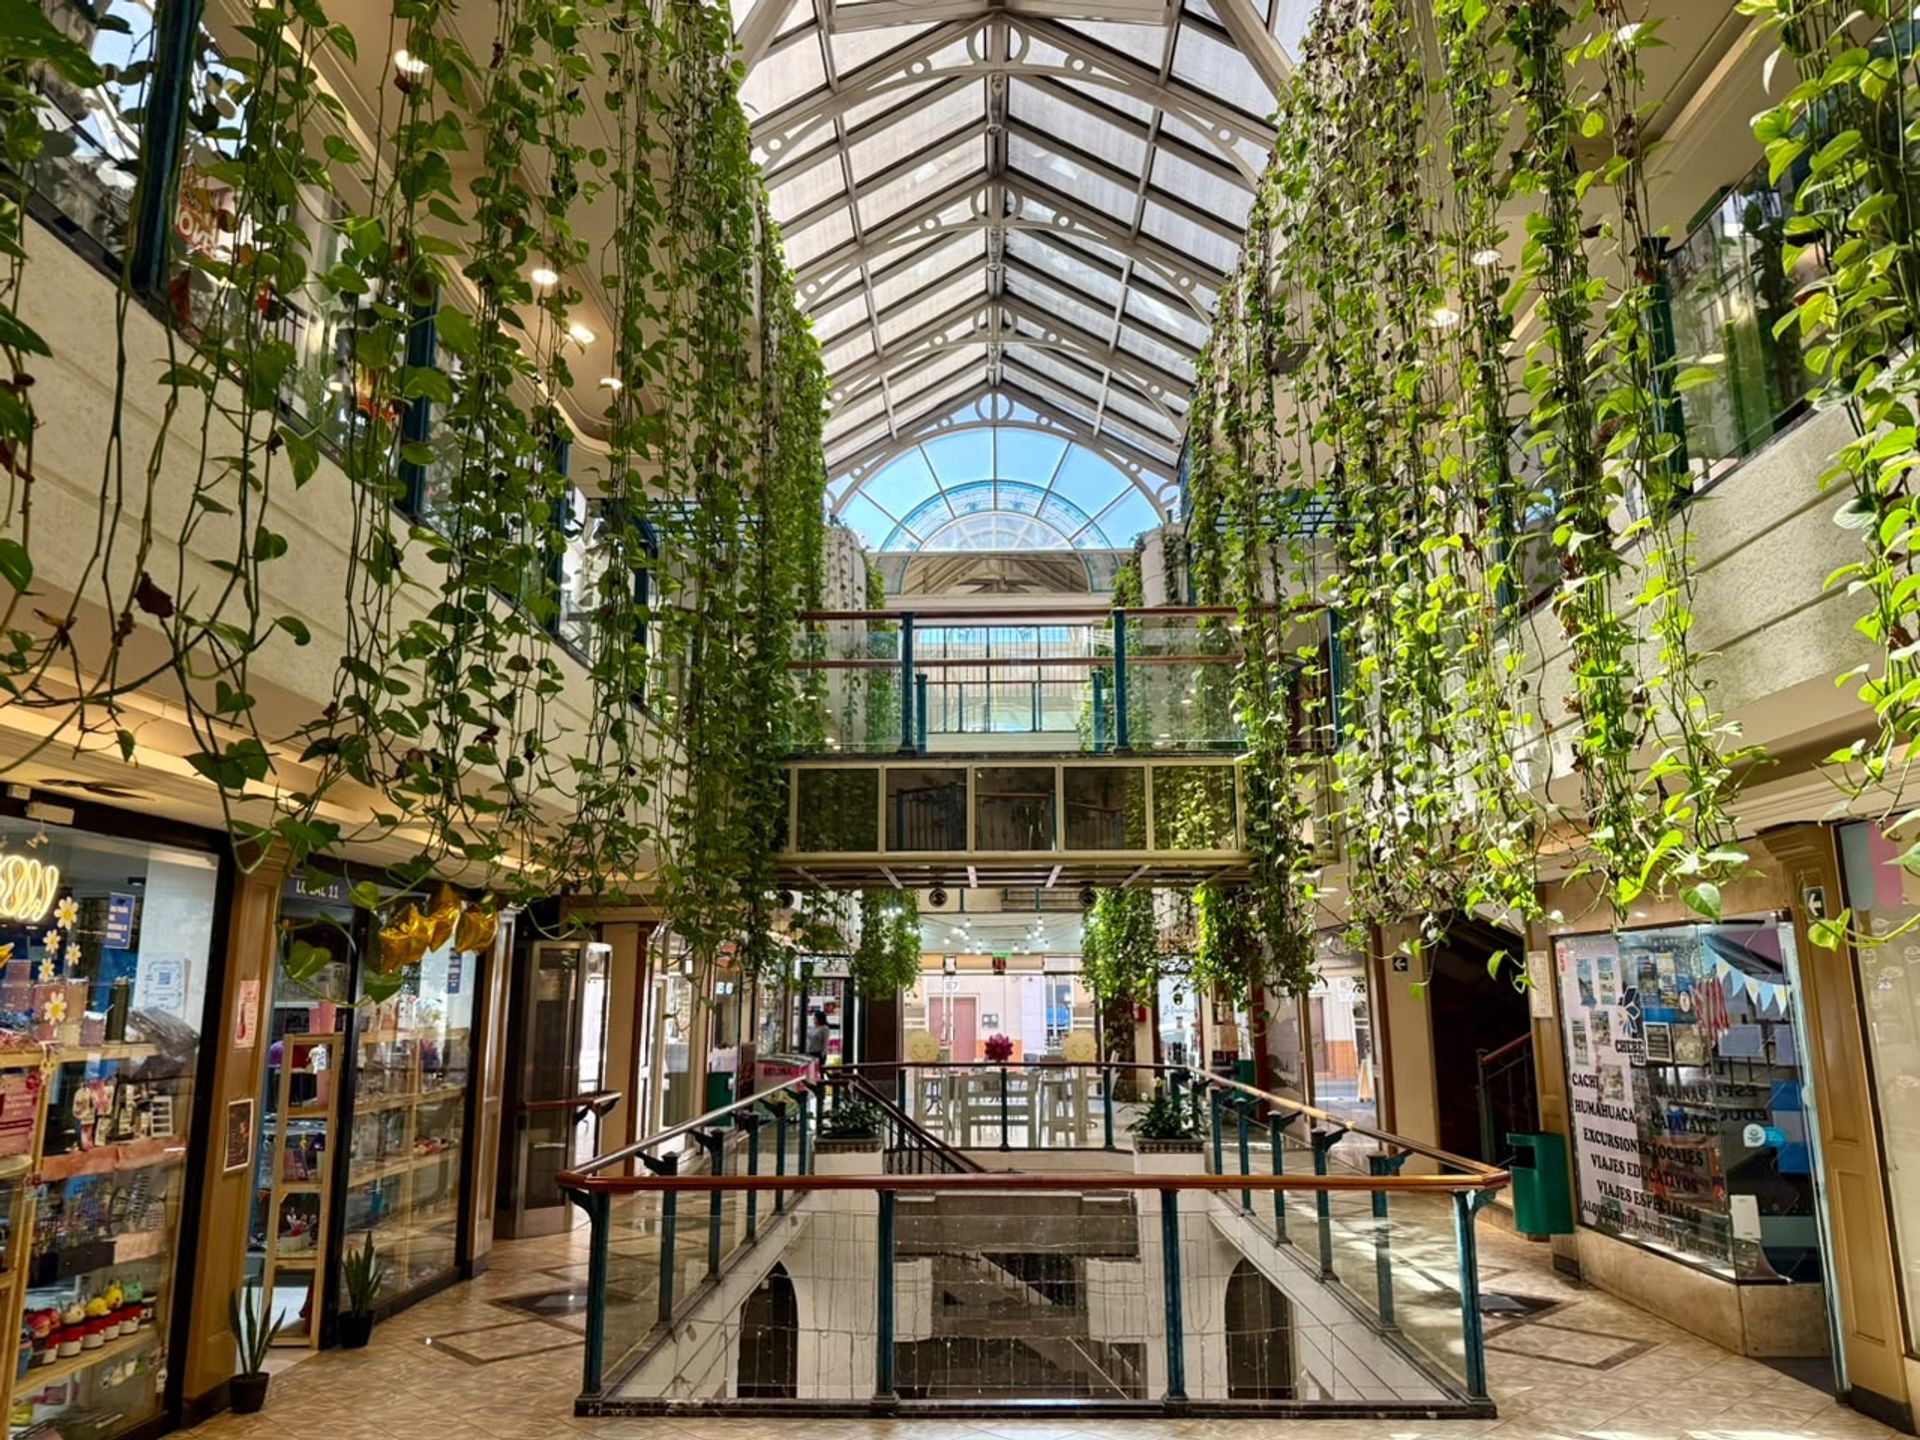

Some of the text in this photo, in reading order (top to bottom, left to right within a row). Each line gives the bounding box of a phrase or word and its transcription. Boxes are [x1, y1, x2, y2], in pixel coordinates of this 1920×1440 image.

[1575, 1099, 1635, 1123] HUMAHUACA
[1583, 1127, 1704, 1167] EXCURSIONES LOCALES
[1590, 1153, 1699, 1193] VIAJES EDUCATIVOS
[1596, 1179, 1702, 1222] VIAJES ESPECIALES
